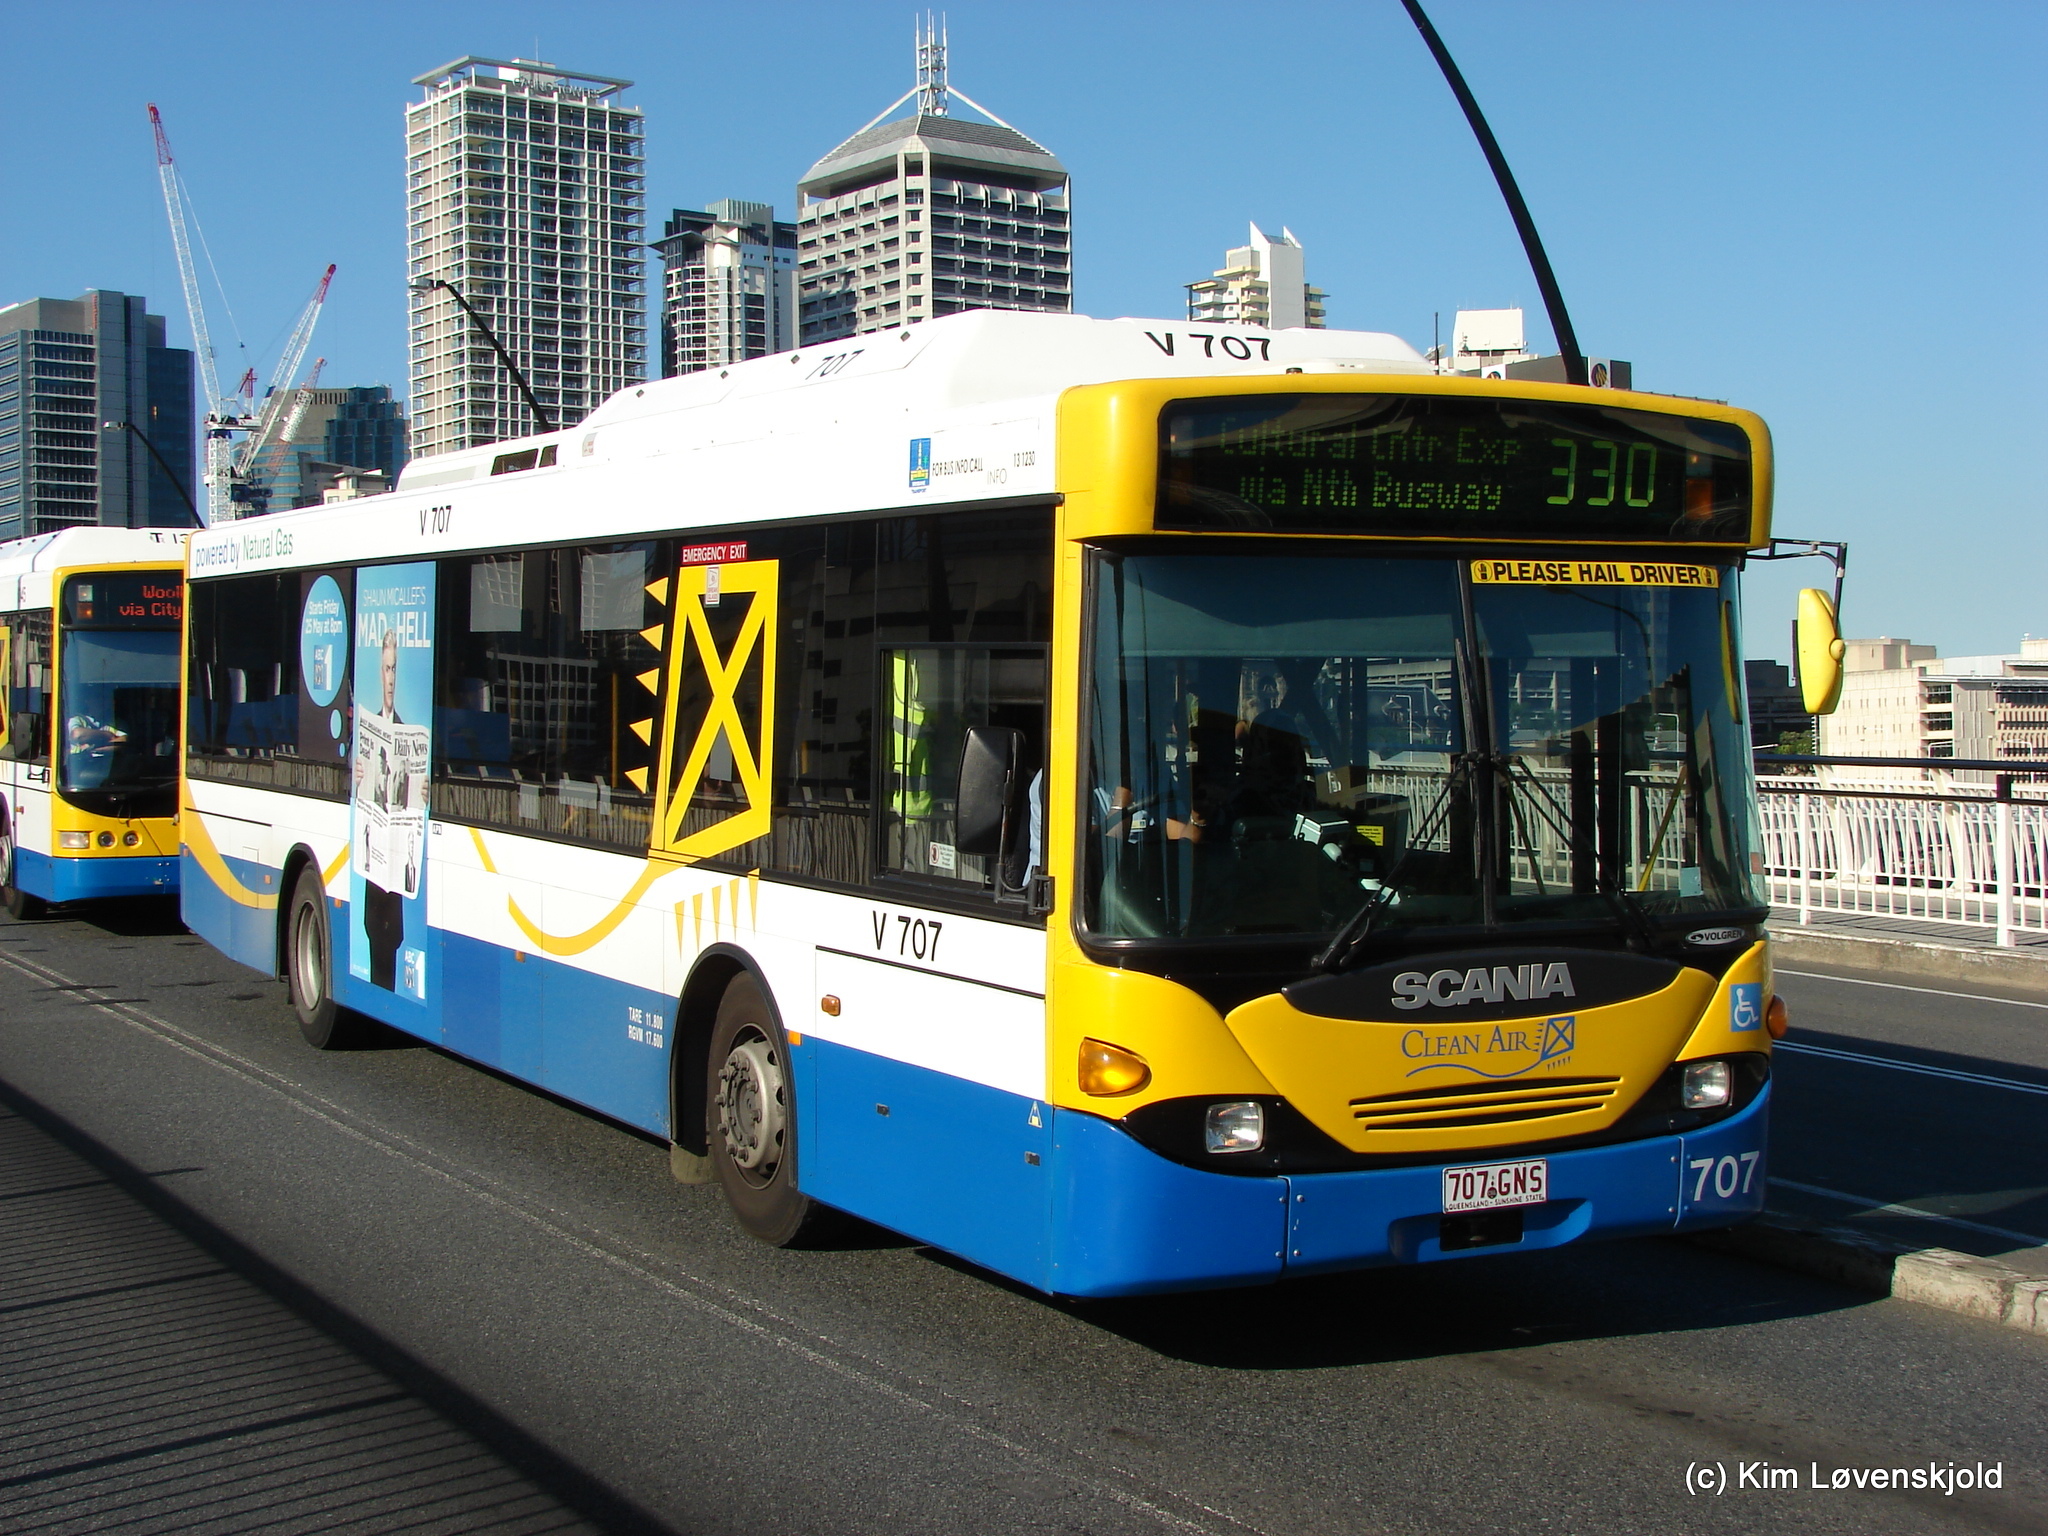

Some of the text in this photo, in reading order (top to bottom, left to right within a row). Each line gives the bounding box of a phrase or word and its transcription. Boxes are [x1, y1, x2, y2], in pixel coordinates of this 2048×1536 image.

[1144, 331, 1271, 361] V 707
[805, 349, 865, 380] 707
[1220, 417, 1357, 460] Cultural
[1371, 423, 1442, 462] Cntr
[932, 457, 983, 476] FOR BUS INFO CALL
[987, 468, 1007, 485] INFO
[1547, 438, 1657, 508] 330
[1239, 466, 1502, 511] via Nth Busway
[420, 505, 452, 536] V 707
[196, 528, 293, 574] powered by Natural Gas
[683, 544, 747, 562] EMERGENCY EXIT
[1493, 562, 1701, 584] PLEASE HAIL DRIVER
[119, 602, 182, 620] via City
[309, 599, 340, 617] Starts Friday
[363, 589, 386, 607] SHAUN
[305, 617, 343, 637] 25 May at 8pm
[358, 611, 431, 648] MAD HELL
[315, 648, 324, 660] ABC
[394, 738, 428, 760] Daily News
[872, 910, 942, 962] V 707
[1704, 929, 1743, 941] VOLGREN
[404, 950, 425, 1000] ABC 1
[1391, 962, 1576, 1010] SCANIA
[628, 1006, 643, 1024] TARE
[628, 1024, 644, 1042] RGVM
[1401, 1025, 1535, 1059] CLEAN AIR
[1448, 1165, 1542, 1201] 707 GNS
[1690, 1150, 1760, 1201] 707
[1448, 1200, 1489, 1211] QUEENSLAND
[1494, 1196, 1523, 1206] SUNSHINE
[1525, 1193, 1542, 1202] STATE
